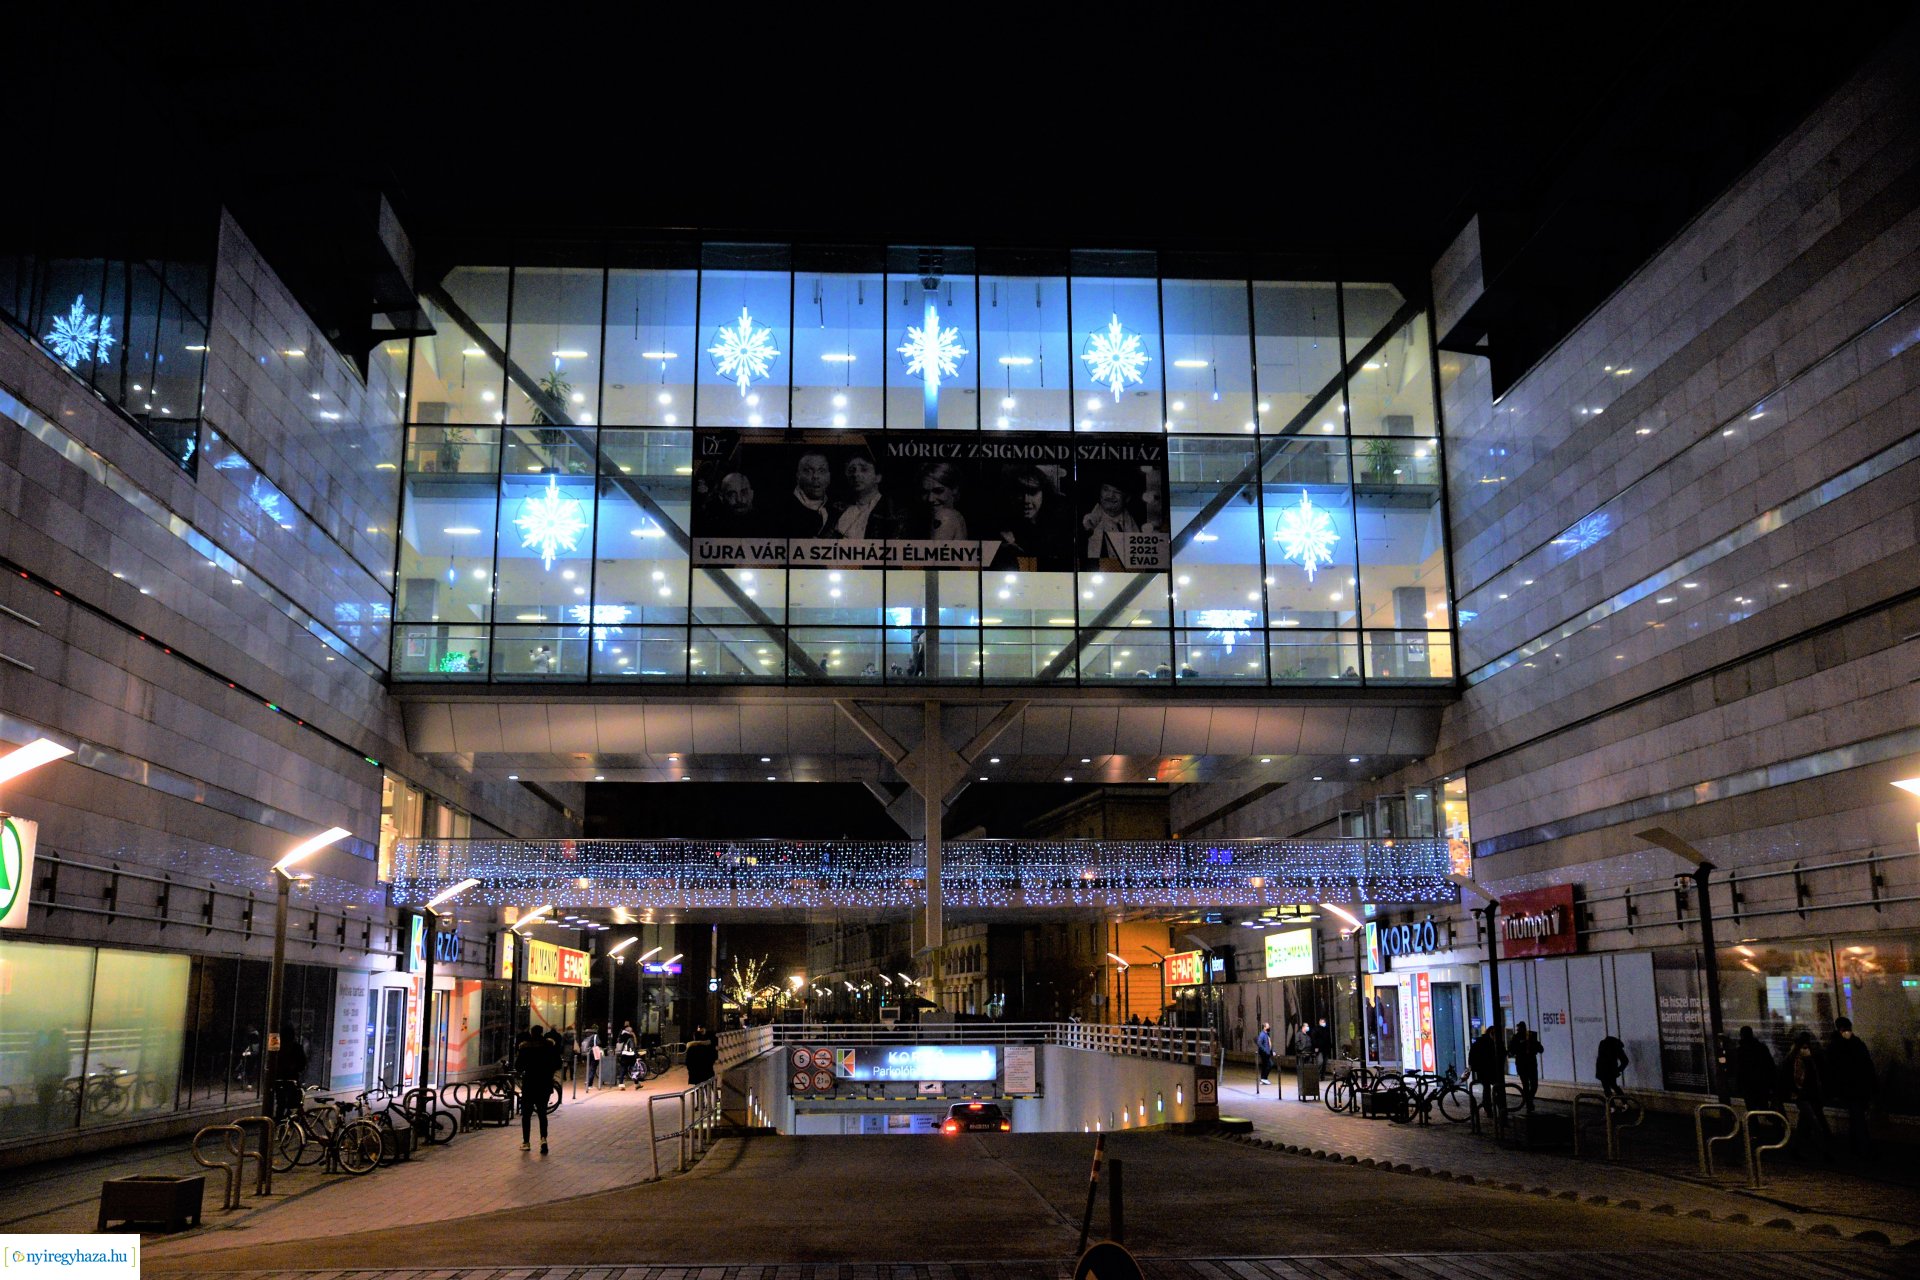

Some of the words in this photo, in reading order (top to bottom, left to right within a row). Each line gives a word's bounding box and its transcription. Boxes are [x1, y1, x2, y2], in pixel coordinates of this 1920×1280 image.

[887, 440, 962, 458] MÓRICZ
[967, 443, 1071, 460] ZSIGMOND
[1076, 442, 1162, 461] SZÍNHÁZ
[1129, 536, 1164, 544] 2020-
[699, 542, 746, 559] ÚJRA
[751, 542, 786, 560] VÁR
[792, 546, 805, 560] A
[810, 543, 897, 561] SZÍNHÁZI
[1130, 556, 1159, 565] ÉVAD
[1381, 914, 1436, 956] KORZÓ
[1503, 910, 1551, 944] Triumph
[421, 930, 459, 962] KRZÓ
[564, 955, 583, 979] SPAR
[1171, 957, 1193, 980] SPAR
[1543, 1013, 1560, 1025] ERSTE
[799, 1055, 805, 1063] 5
[1203, 1083, 1209, 1092] 5
